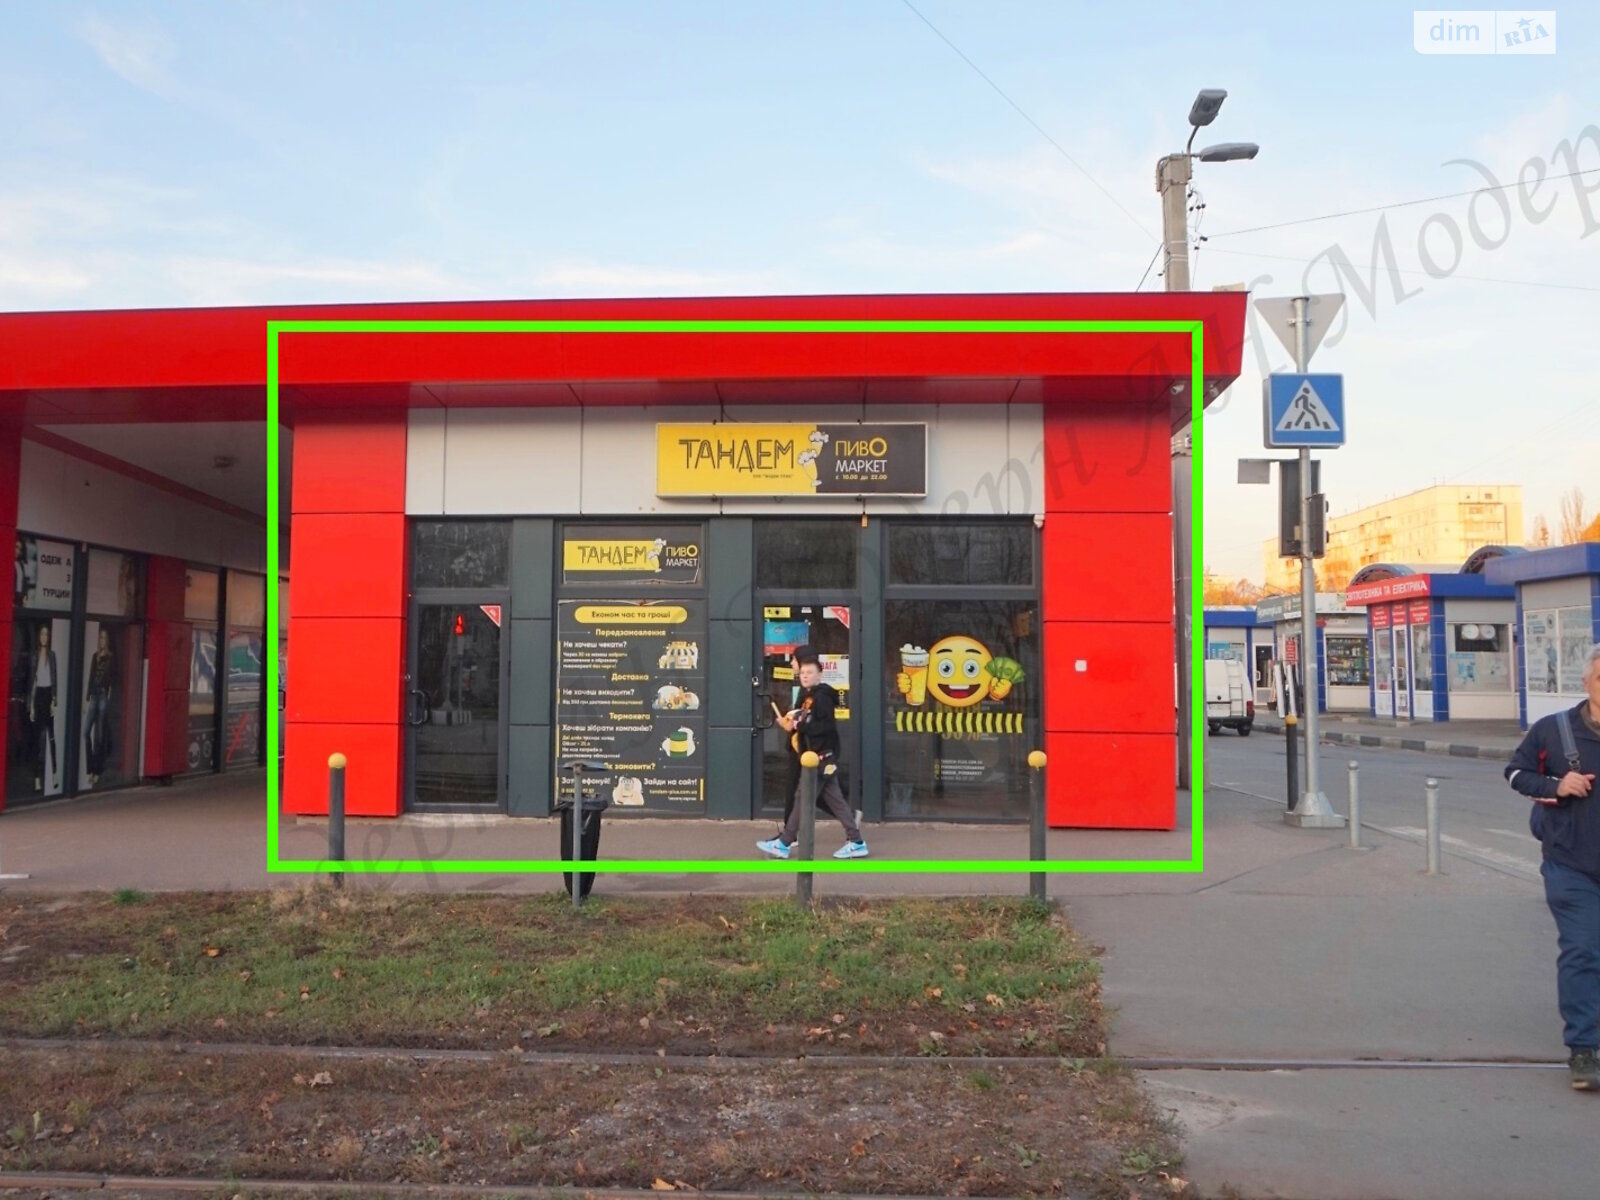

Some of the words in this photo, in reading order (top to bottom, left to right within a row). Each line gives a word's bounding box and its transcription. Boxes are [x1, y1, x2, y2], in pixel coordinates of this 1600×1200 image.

[835, 437, 888, 457] ПИВО
[678, 439, 794, 472] ТАНДЕМ
[835, 459, 888, 473] МАРКЕТ
[577, 545, 647, 565] ТАНДЕМ
[665, 544, 698, 558] ПИВО
[665, 558, 698, 567] МАРКЕТ
[648, 611, 670, 620] гроші
[595, 628, 666, 637] Передзамовлення
[611, 673, 649, 681] Доставка
[609, 712, 650, 720] Термокега
[587, 724, 614, 732] зібрати
[614, 762, 656, 770] замовити?
[562, 777, 611, 785] Затефонуй!
[644, 778, 666, 786] Зайди
